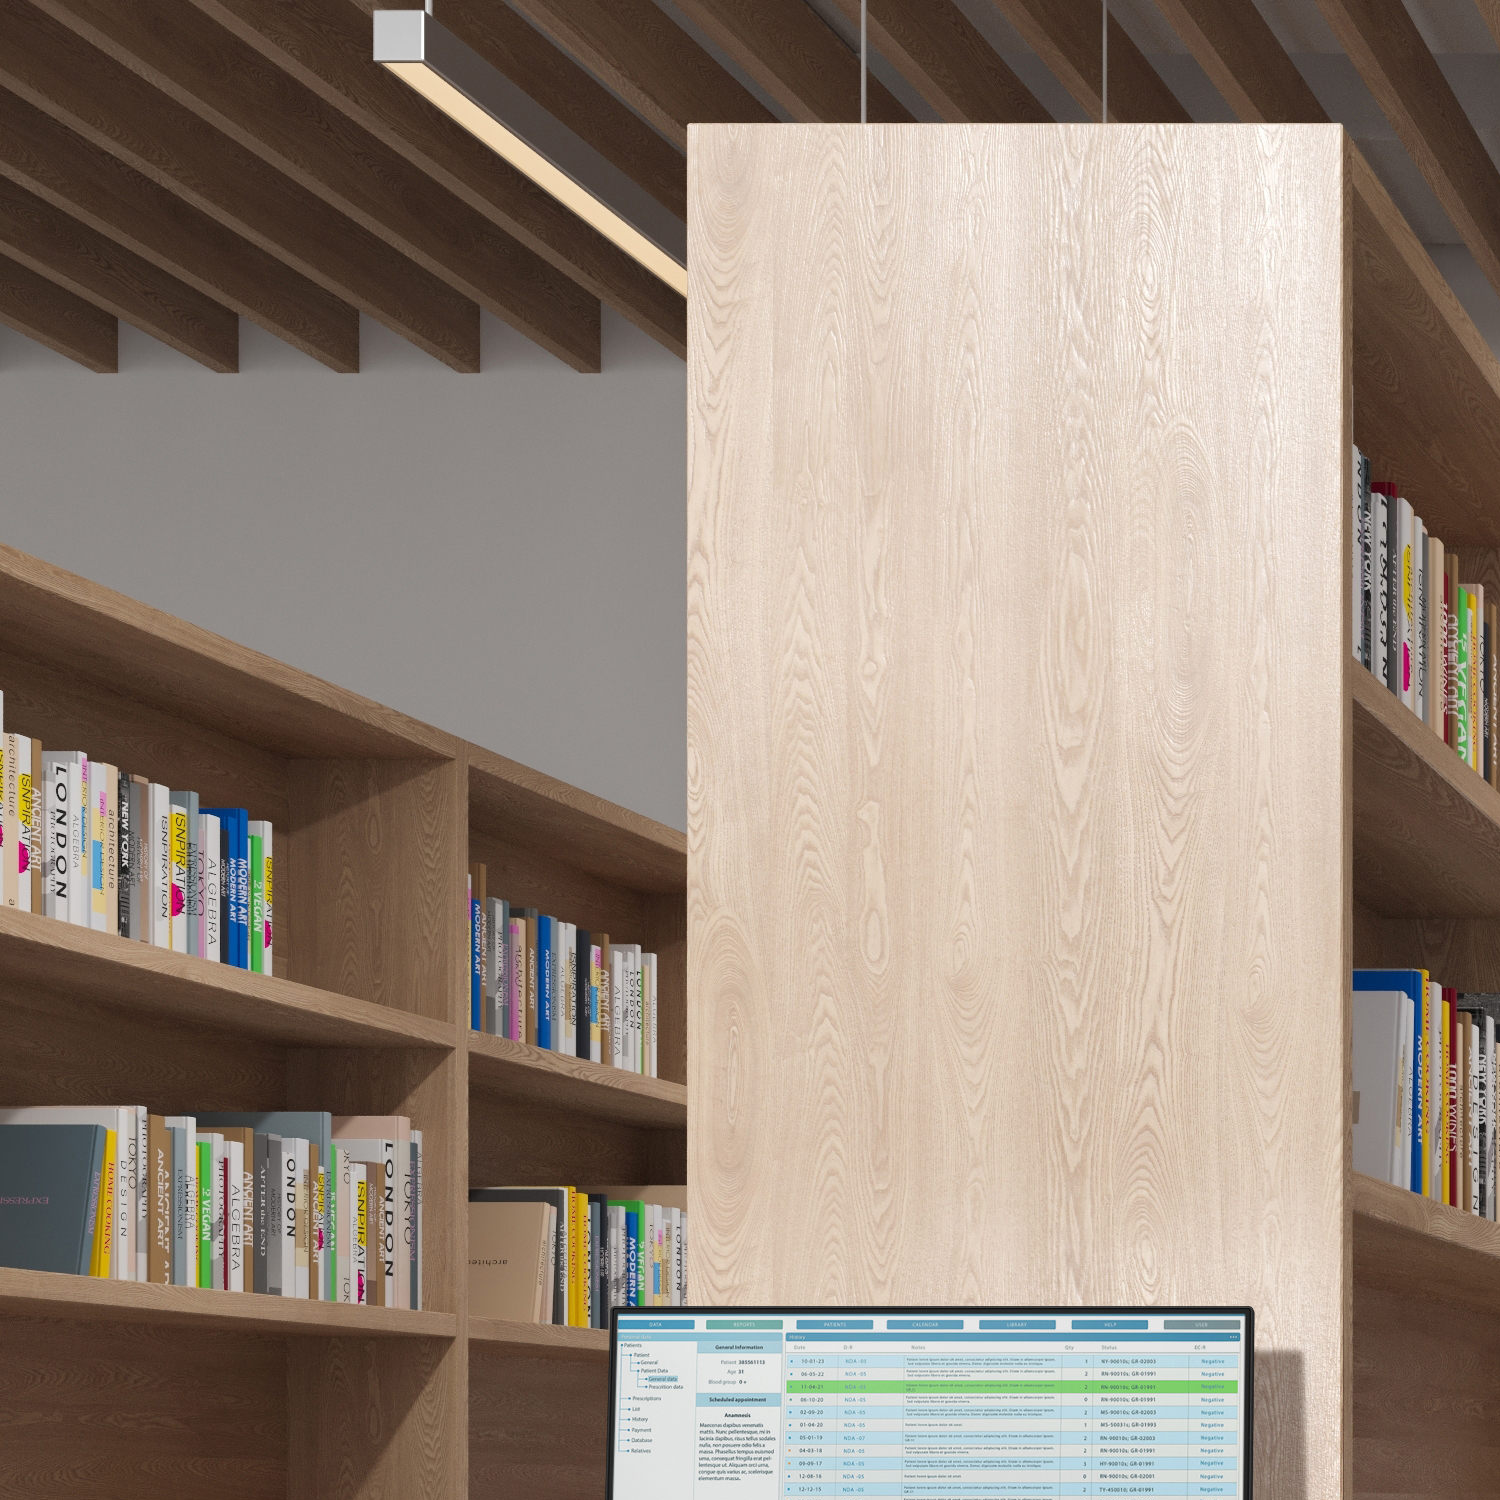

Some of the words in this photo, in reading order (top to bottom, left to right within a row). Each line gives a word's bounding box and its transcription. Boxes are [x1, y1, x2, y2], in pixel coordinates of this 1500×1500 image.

[21, 773, 31, 872] ISNPIRATION
[55, 766, 67, 898] LONDON
[121, 800, 129, 830] NEW
[121, 832, 129, 868] YORK
[175, 812, 186, 915] ISNPIRATION
[207, 858, 217, 946] ALGEBRA
[128, 1137, 137, 1189] TOKYO
[103, 1201, 112, 1255] COOKING
[231, 1184, 241, 1271] ALGEBRA
[385, 1143, 393, 1277] LONDON
